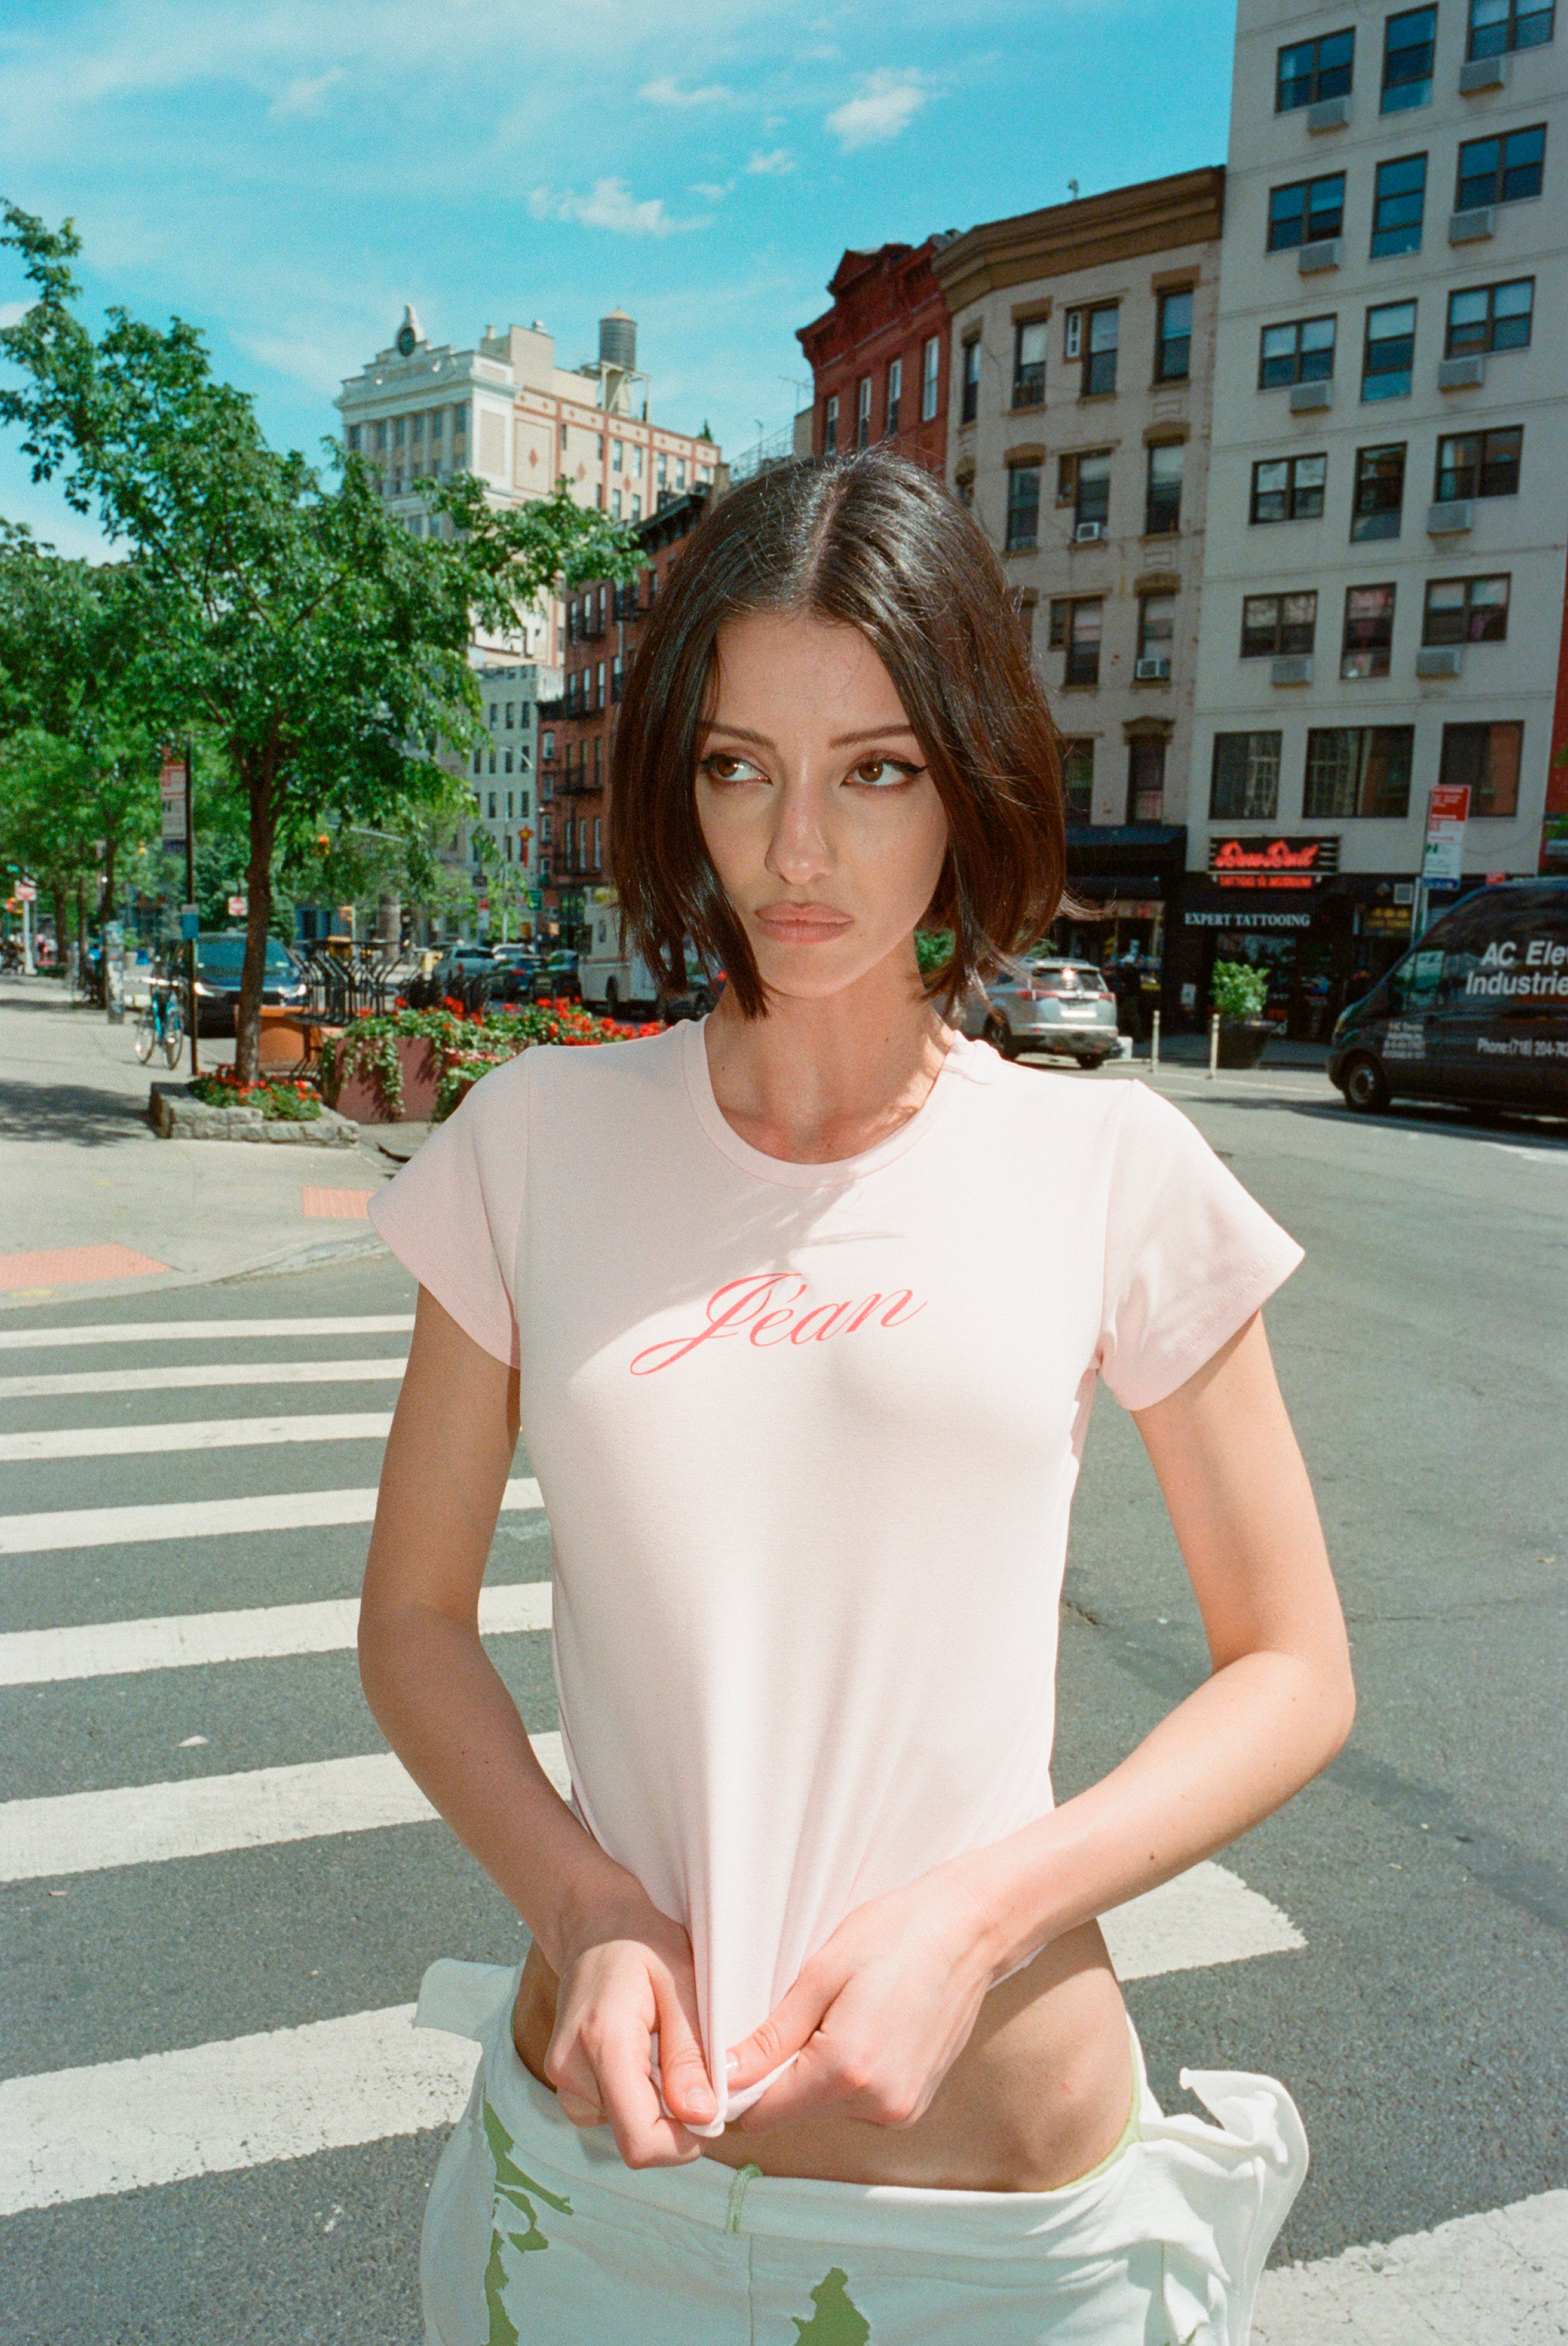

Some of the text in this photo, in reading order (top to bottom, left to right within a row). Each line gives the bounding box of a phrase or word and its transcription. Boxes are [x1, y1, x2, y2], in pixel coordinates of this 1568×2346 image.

[1185, 912, 1311, 926] EXPERT TATTOOING
[1480, 940, 1568, 966] AC Ele
